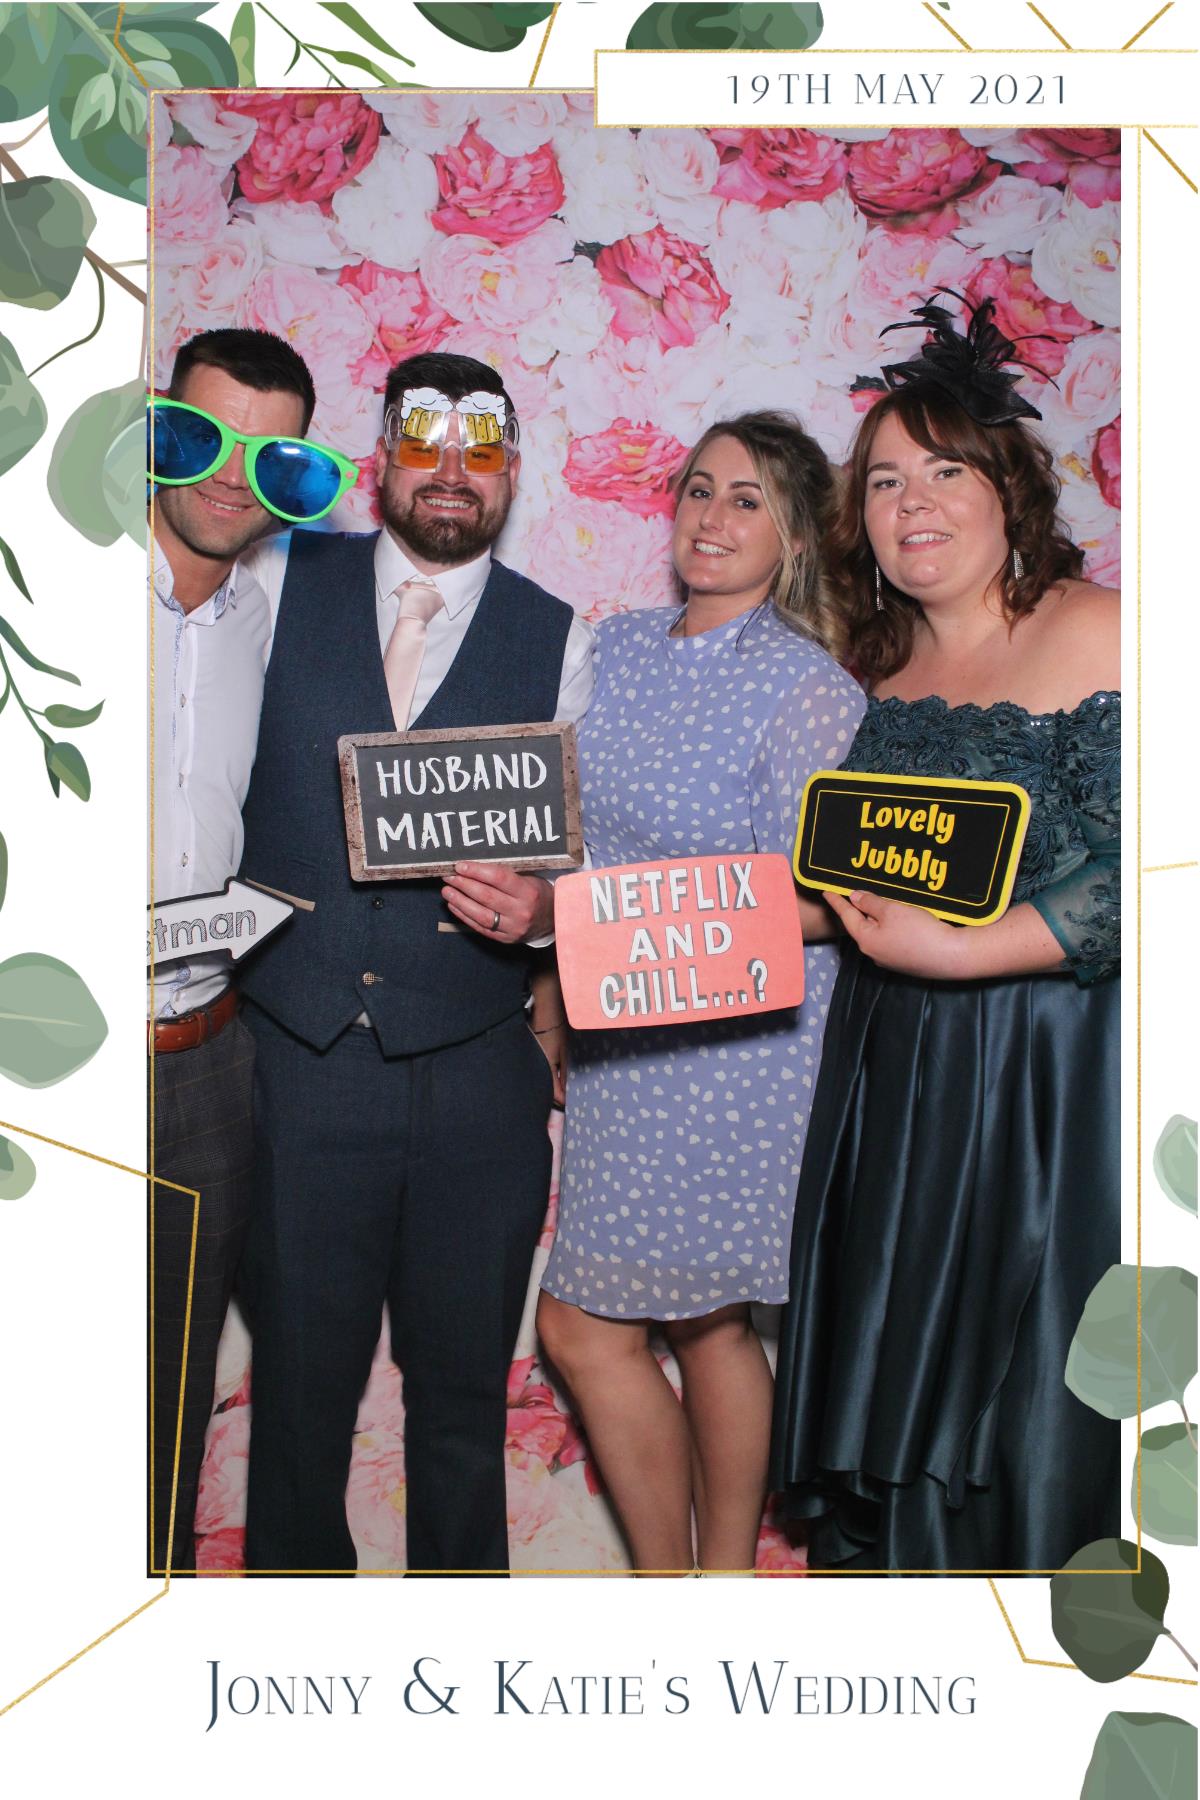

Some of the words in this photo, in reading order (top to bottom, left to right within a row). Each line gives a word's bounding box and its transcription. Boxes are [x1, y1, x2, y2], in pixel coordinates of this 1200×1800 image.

[376, 752, 547, 798] HUSBAND
[376, 805, 560, 852] MATERIAL
[860, 801, 955, 844] Lovely
[851, 840, 948, 891] Jubbly
[590, 861, 758, 923] NETFLIX
[147, 909, 256, 957] tman
[629, 920, 733, 963] AND
[599, 957, 768, 1019] CHILL...?
